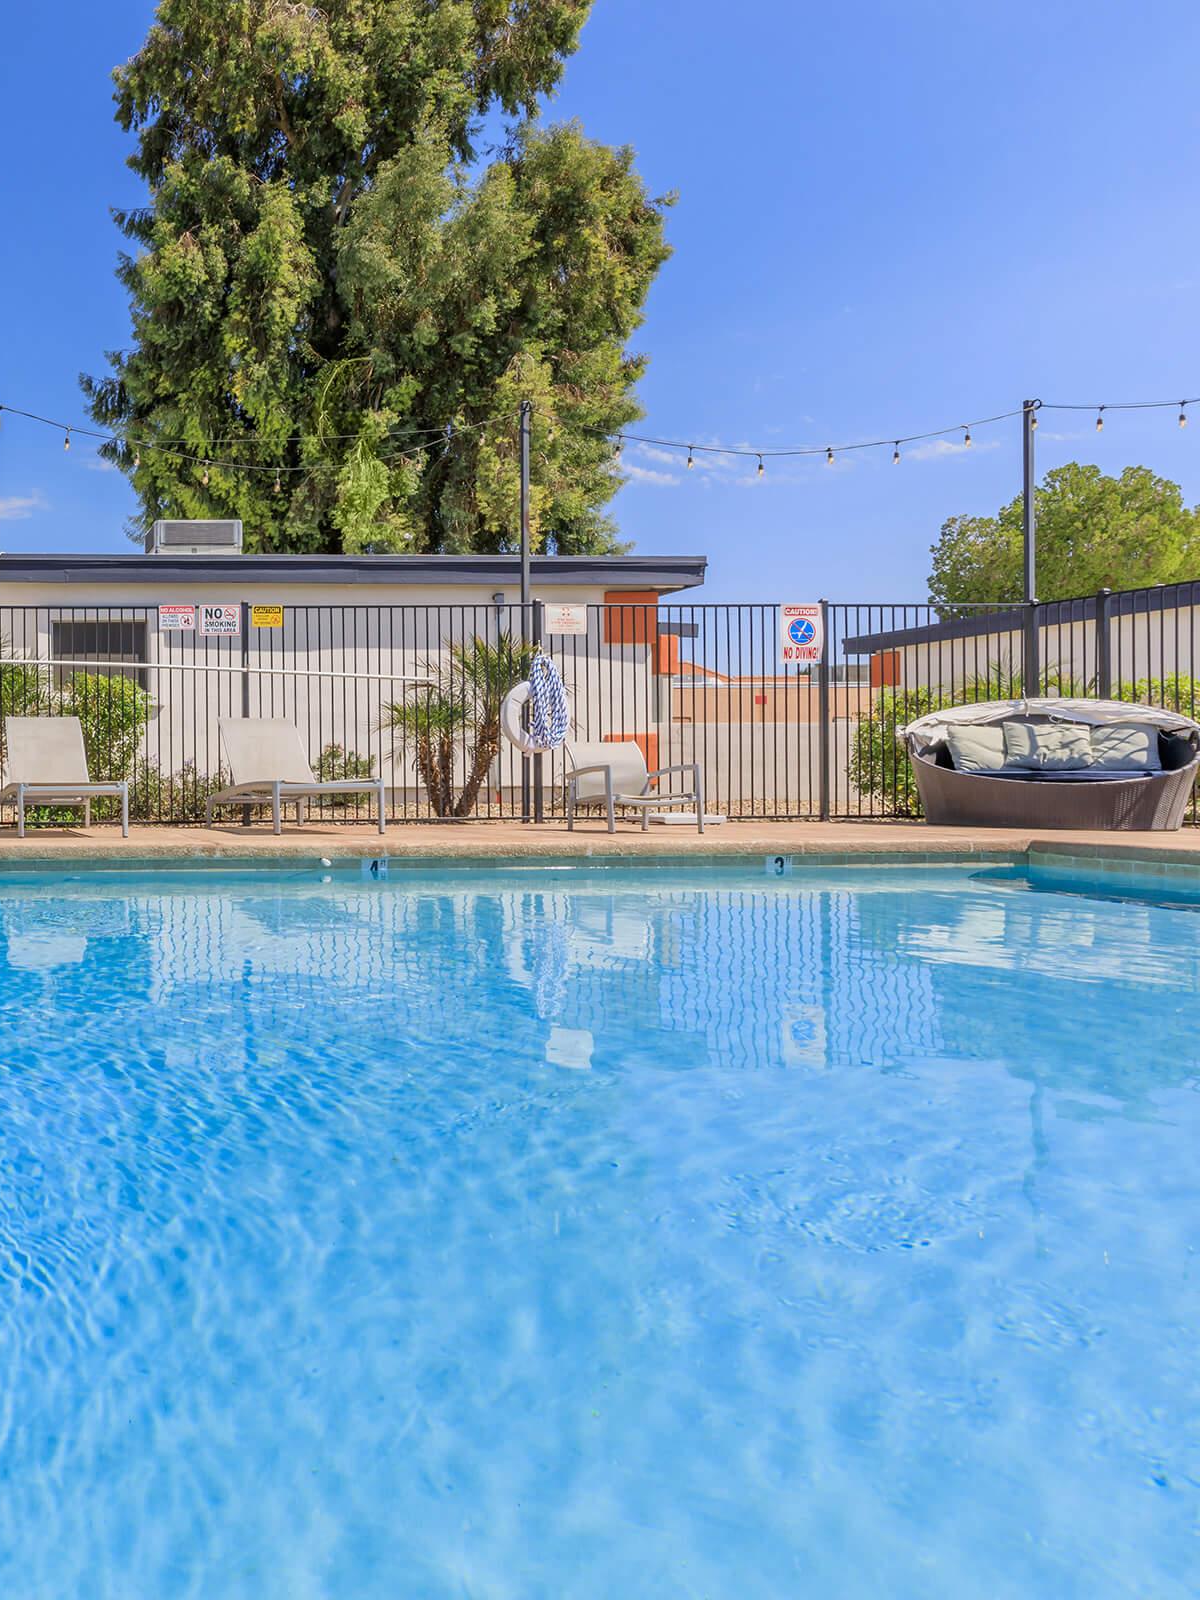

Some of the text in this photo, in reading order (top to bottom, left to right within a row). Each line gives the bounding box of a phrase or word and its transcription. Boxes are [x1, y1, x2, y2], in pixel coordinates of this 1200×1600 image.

[205, 608, 223, 619] NO
[204, 620, 236, 628] SMOKING
[784, 647, 819, 659] NO DIVING!
